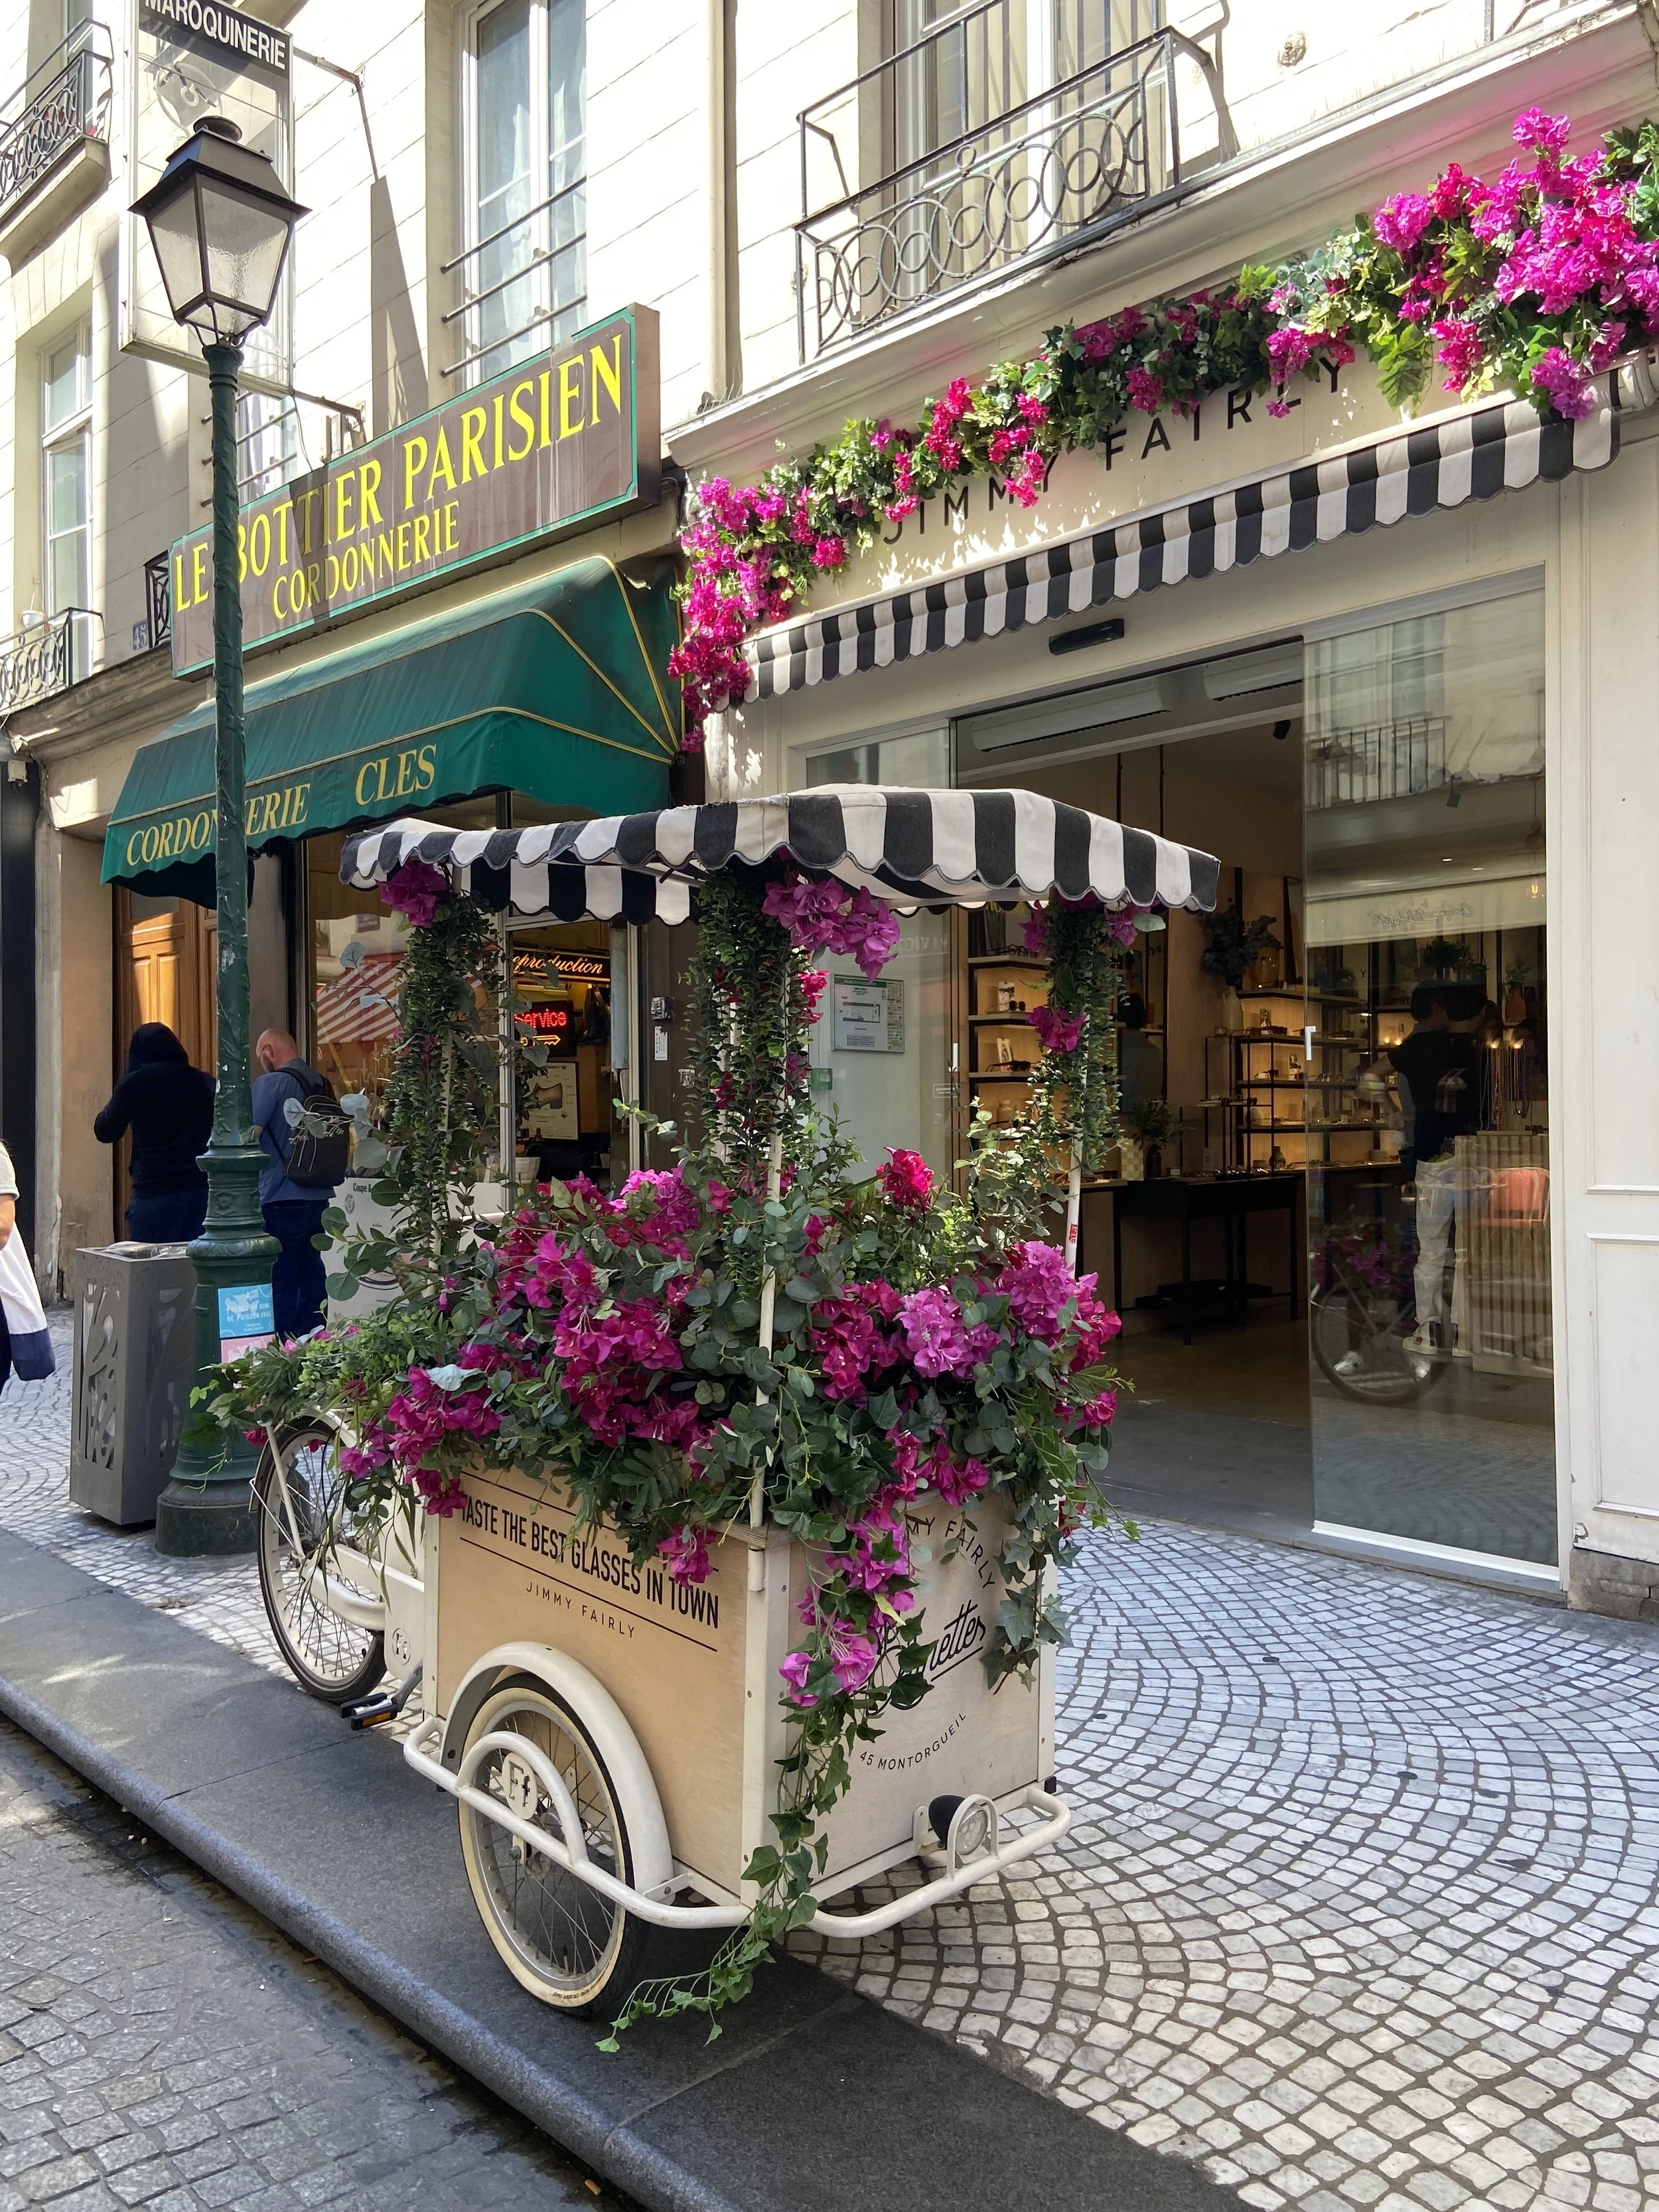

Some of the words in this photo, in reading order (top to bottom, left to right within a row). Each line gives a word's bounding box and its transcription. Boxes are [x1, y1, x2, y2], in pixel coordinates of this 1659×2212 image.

[145, 0, 286, 70] MAROQUINERIE
[174, 542, 209, 613] LE
[238, 459, 383, 584] BOTTIER
[403, 334, 622, 510] PARISIEN
[273, 500, 460, 619] CORDONNERIE
[133, 624, 147, 649] 45
[355, 744, 437, 806] CLES
[512, 954, 603, 974] eproduction
[353, 1183, 367, 1193] Coupe
[461, 1495, 498, 1536] TASTE
[502, 1509, 528, 1548] THE
[532, 1520, 567, 1563] BEST
[571, 1538, 641, 1595] GLASSES
[646, 1567, 664, 1605] IN
[668, 1576, 719, 1629] TOWN
[944, 1519, 995, 1589] FAIRLY
[526, 1581, 572, 1611] JIMMY
[581, 1604, 636, 1639] FAIRLY
[859, 1750, 875, 1766] 45
[877, 1713, 967, 1771] MONTORGUEIL
